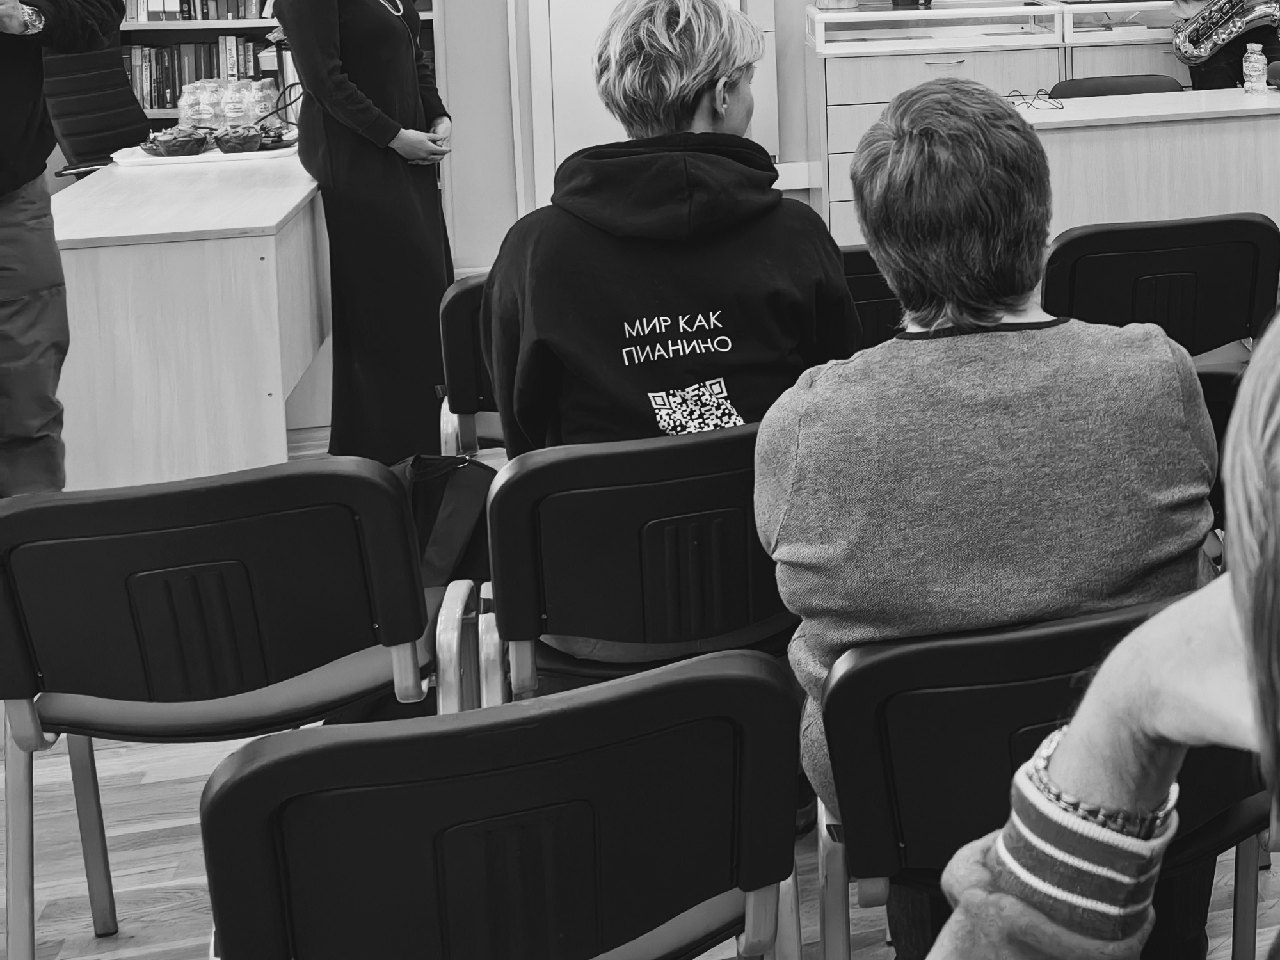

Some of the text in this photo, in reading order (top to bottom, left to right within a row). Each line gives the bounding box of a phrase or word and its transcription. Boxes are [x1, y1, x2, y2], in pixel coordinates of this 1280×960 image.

[623, 310, 723, 338] МИР КАК
[622, 335, 732, 366] ПИАНИНО
